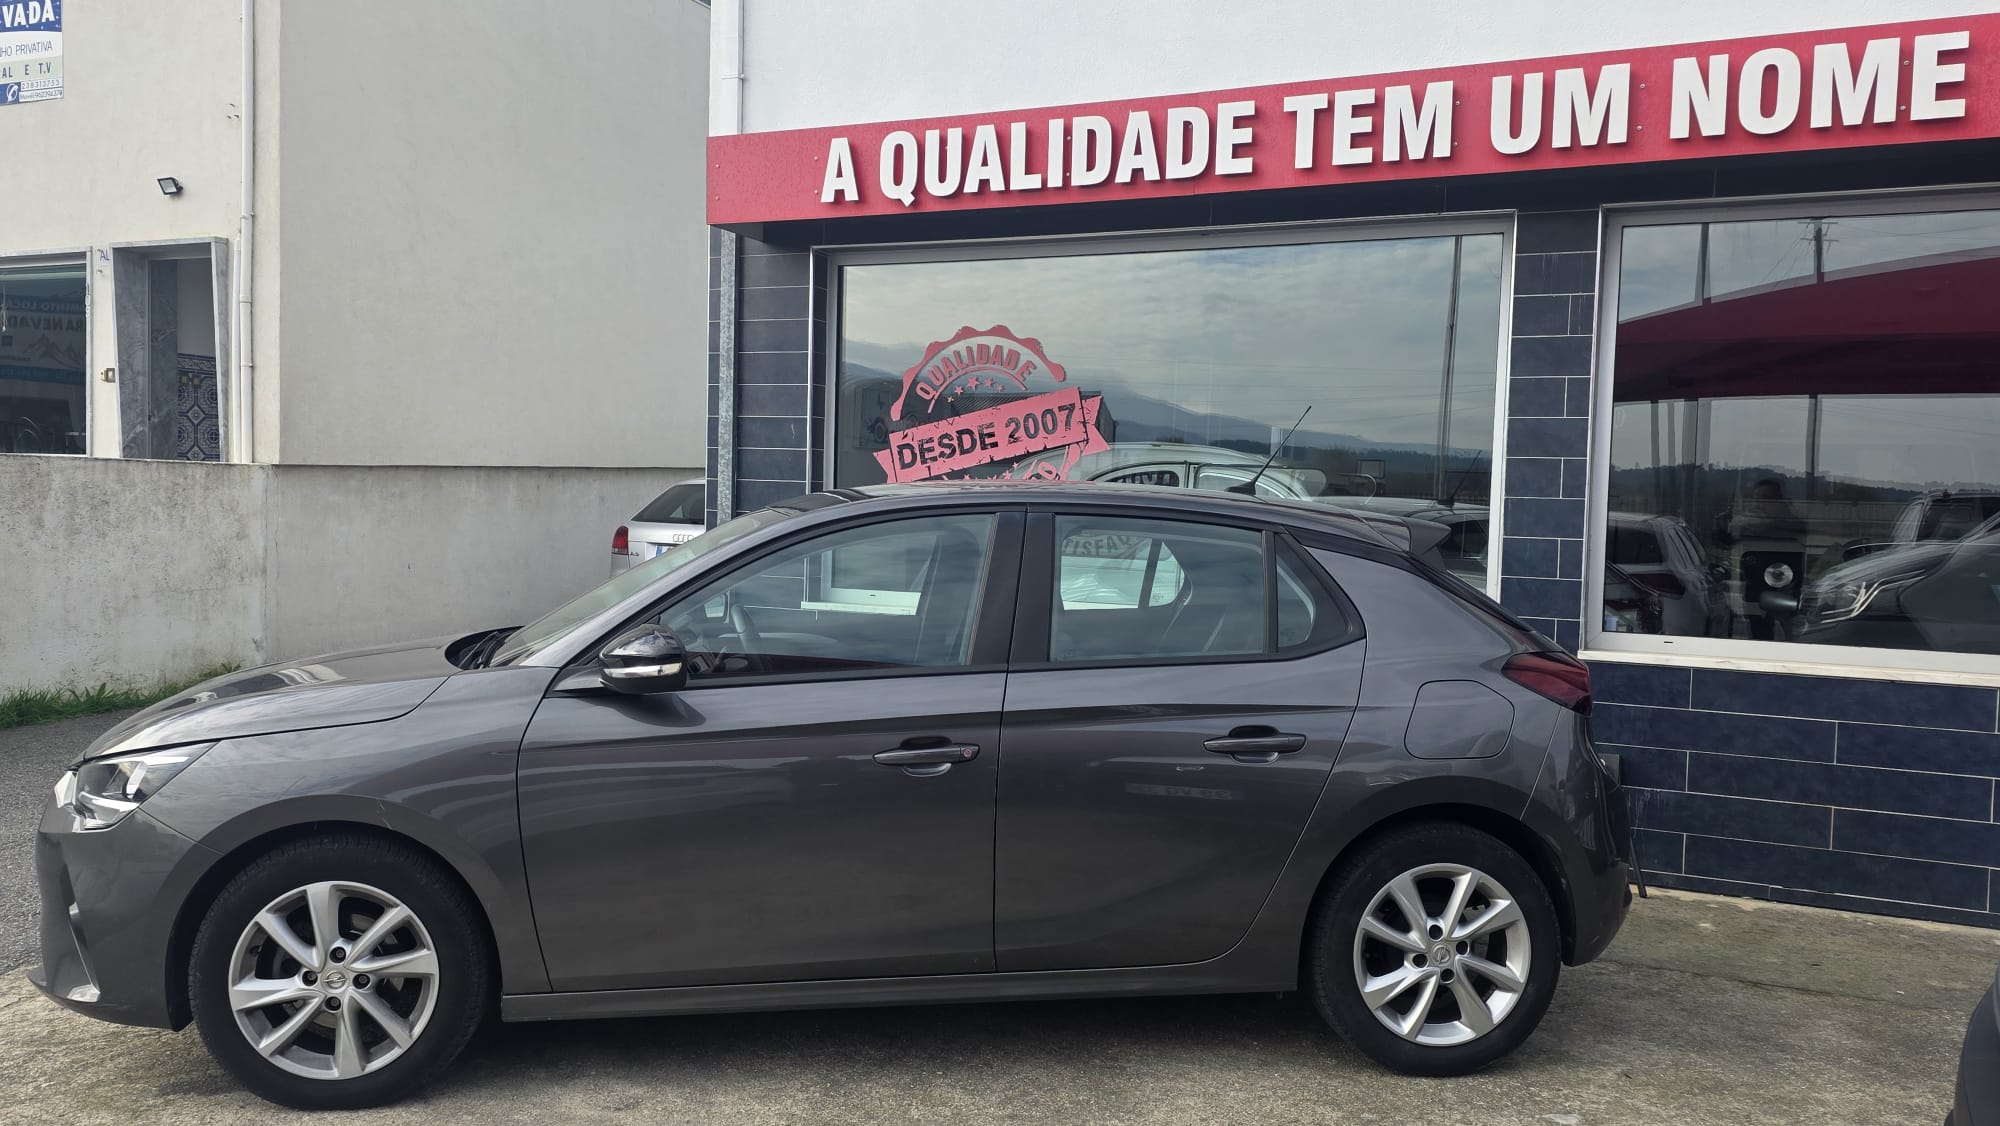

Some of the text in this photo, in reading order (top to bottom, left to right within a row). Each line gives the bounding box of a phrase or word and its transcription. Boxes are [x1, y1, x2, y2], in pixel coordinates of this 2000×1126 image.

[2, 0, 55, 28] VADA
[16, 40, 53, 55] PRIVATIVA
[24, 64, 29, 76] E
[820, 31, 1970, 207] A QUALIDADE TEM UM NOME
[915, 343, 1038, 400] QUALIDADE
[896, 421, 999, 470] DESDE
[1005, 402, 1076, 445] 2007
